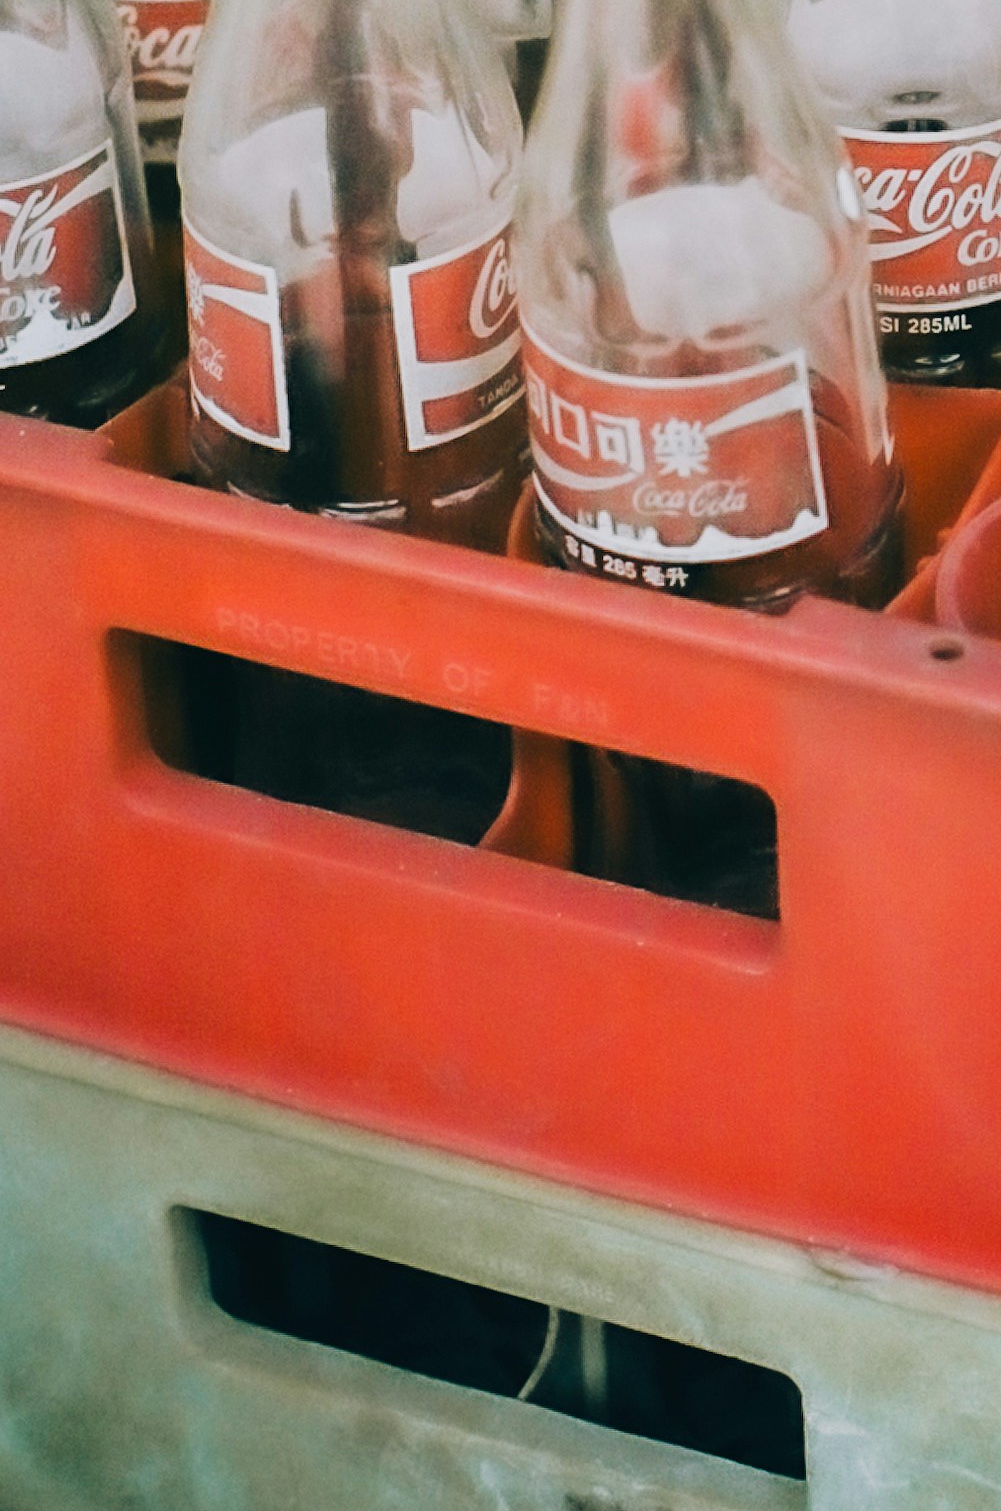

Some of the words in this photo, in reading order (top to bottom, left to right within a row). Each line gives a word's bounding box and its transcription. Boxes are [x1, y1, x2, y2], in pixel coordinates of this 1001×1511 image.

[907, 313, 973, 334] 285ML
[215, 607, 414, 680] PROPERTY
[441, 660, 496, 697] OF
